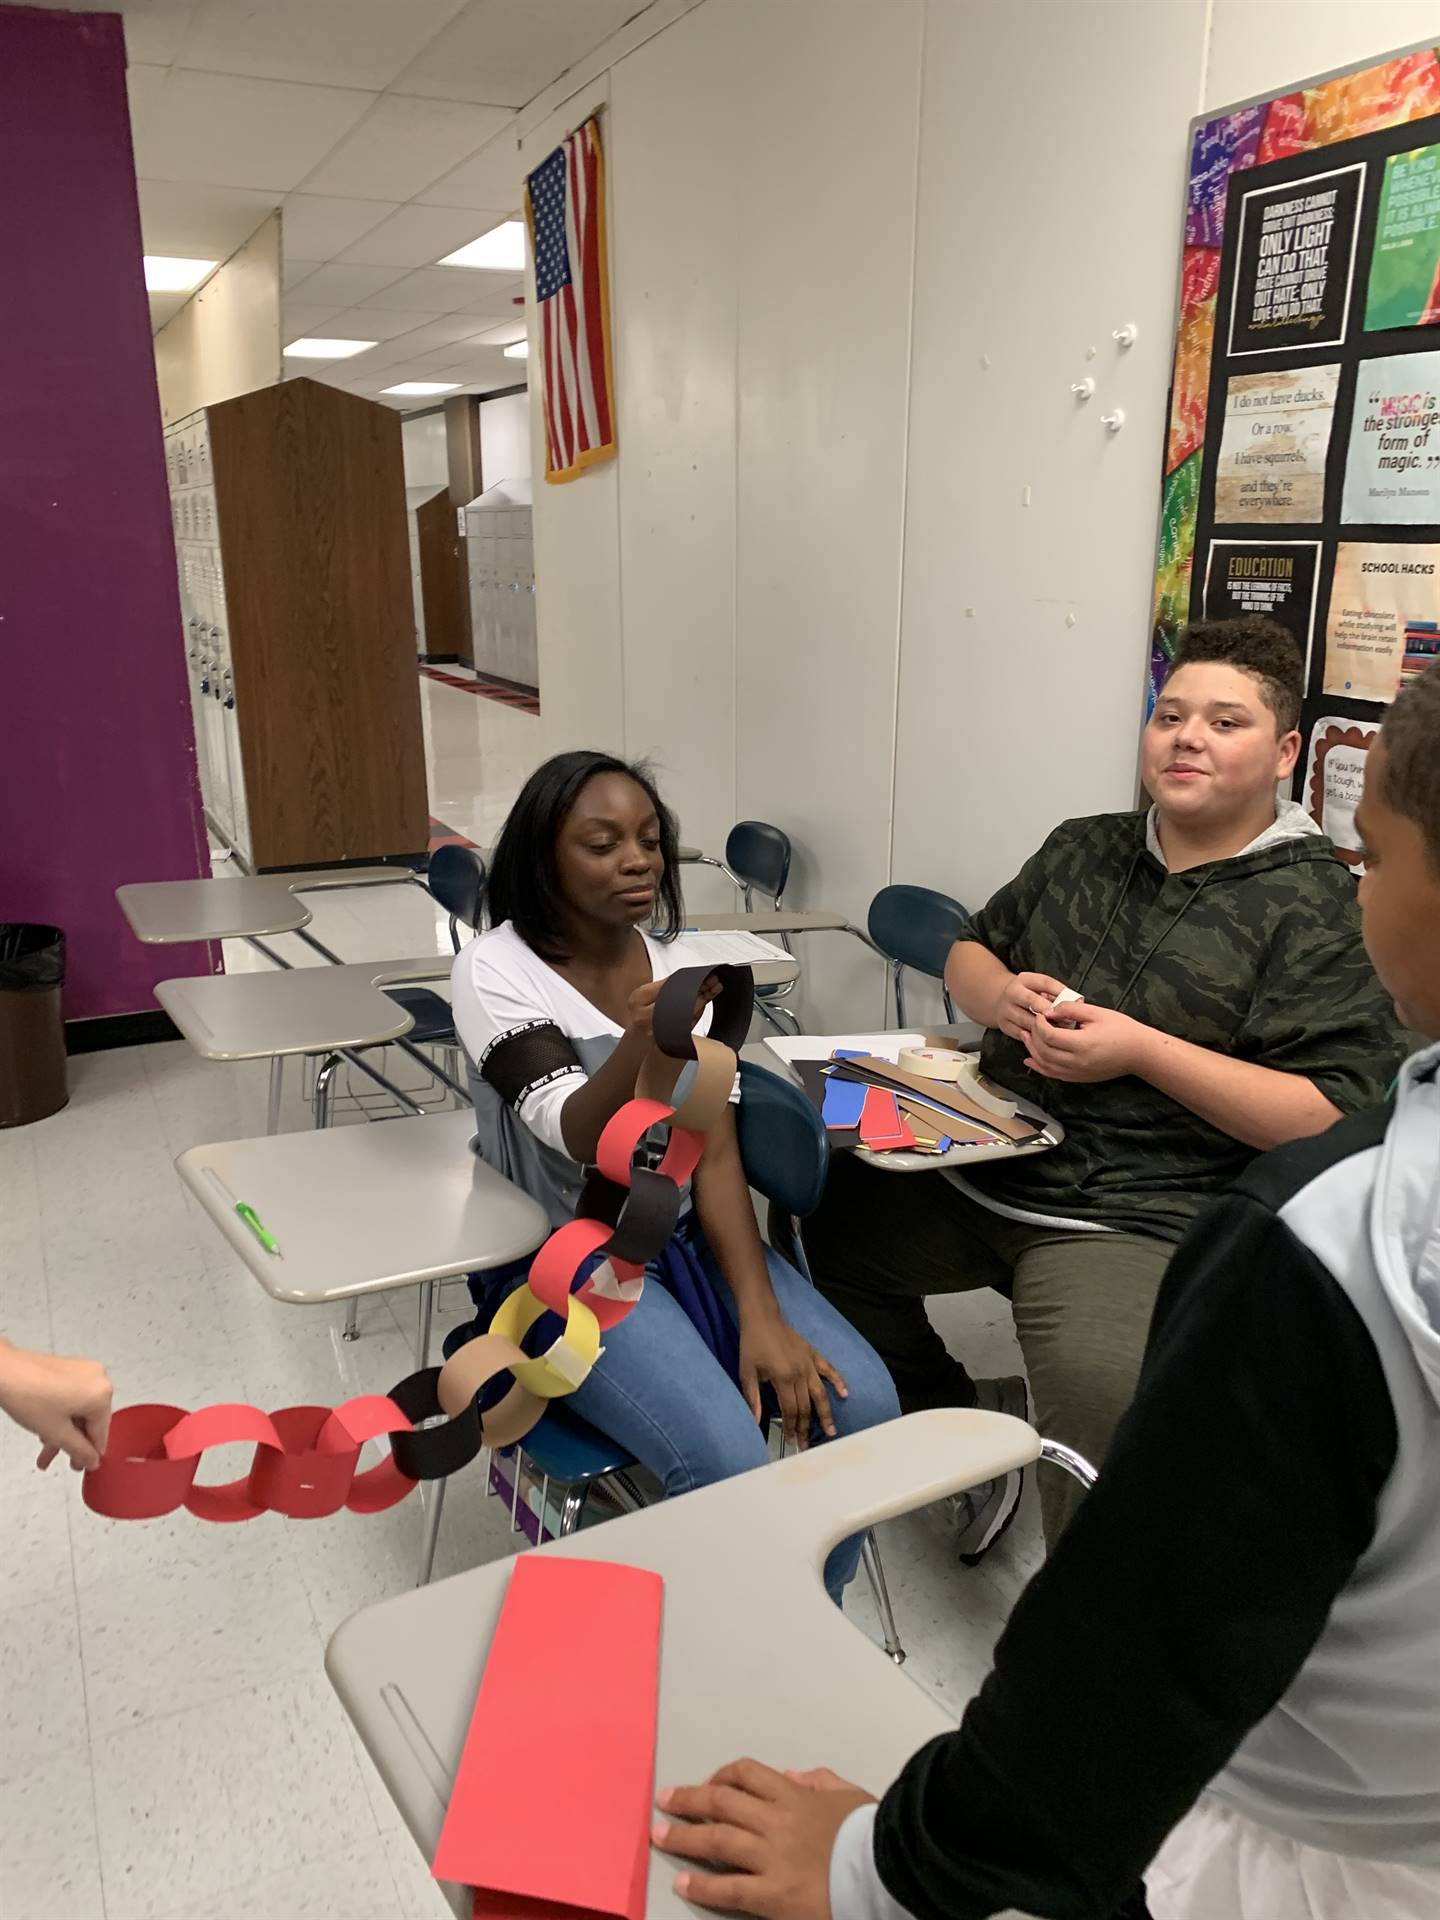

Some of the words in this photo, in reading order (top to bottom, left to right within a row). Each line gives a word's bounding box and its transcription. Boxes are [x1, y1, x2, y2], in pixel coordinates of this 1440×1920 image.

[1263, 198, 1304, 220] DARKNESS
[1304, 188, 1338, 211] CANNOT
[1259, 229, 1293, 257] ONLY
[1293, 220, 1334, 251] LIGHT
[1257, 255, 1281, 278] CAN
[1280, 252, 1297, 273] DO
[1298, 246, 1328, 270] THAT.
[1255, 276, 1275, 291] HATE
[1275, 270, 1304, 288] CANNOT
[1303, 265, 1328, 282] DRIVE
[1254, 289, 1273, 307] OUT
[1300, 280, 1326, 300] ONLY
[1252, 306, 1272, 322] LOVE
[1272, 303, 1289, 319] CAN
[1288, 301, 1300, 316] DO
[1233, 395, 1239, 408] I
[1239, 396, 1252, 408] do
[1252, 398, 1269, 407] not
[1270, 392, 1292, 405] have
[1422, 391, 1437, 410] is
[1251, 422, 1265, 435] Or
[1265, 425, 1272, 434] a
[1363, 415, 1383, 432] the
[1377, 433, 1409, 451] form
[1413, 428, 1431, 448] of
[1240, 451, 1263, 464] have
[1239, 480, 1258, 493] and
[1239, 496, 1295, 510] everywhere.
[1228, 557, 1294, 577] EDUCATION
[1361, 562, 1401, 574] SCHOOL
[1401, 563, 1435, 575] HACKS
[1342, 608, 1363, 620] Eating
[1363, 610, 1395, 620] chocolate
[1338, 620, 1355, 629] while
[1356, 621, 1384, 633] studying
[1385, 623, 1397, 631] will
[1334, 630, 1348, 641] help
[1348, 631, 1360, 640] the
[1360, 632, 1377, 641] brain
[1378, 634, 1398, 644] retain
[1336, 642, 1374, 652] information
[1374, 645, 1393, 657] easily
[1335, 762, 1348, 772] you
[510, 1023, 531, 1036] NOPE
[532, 1019, 551, 1027] NOPE
[530, 1074, 550, 1090] NOPE
[550, 1066, 570, 1079] NOPE
